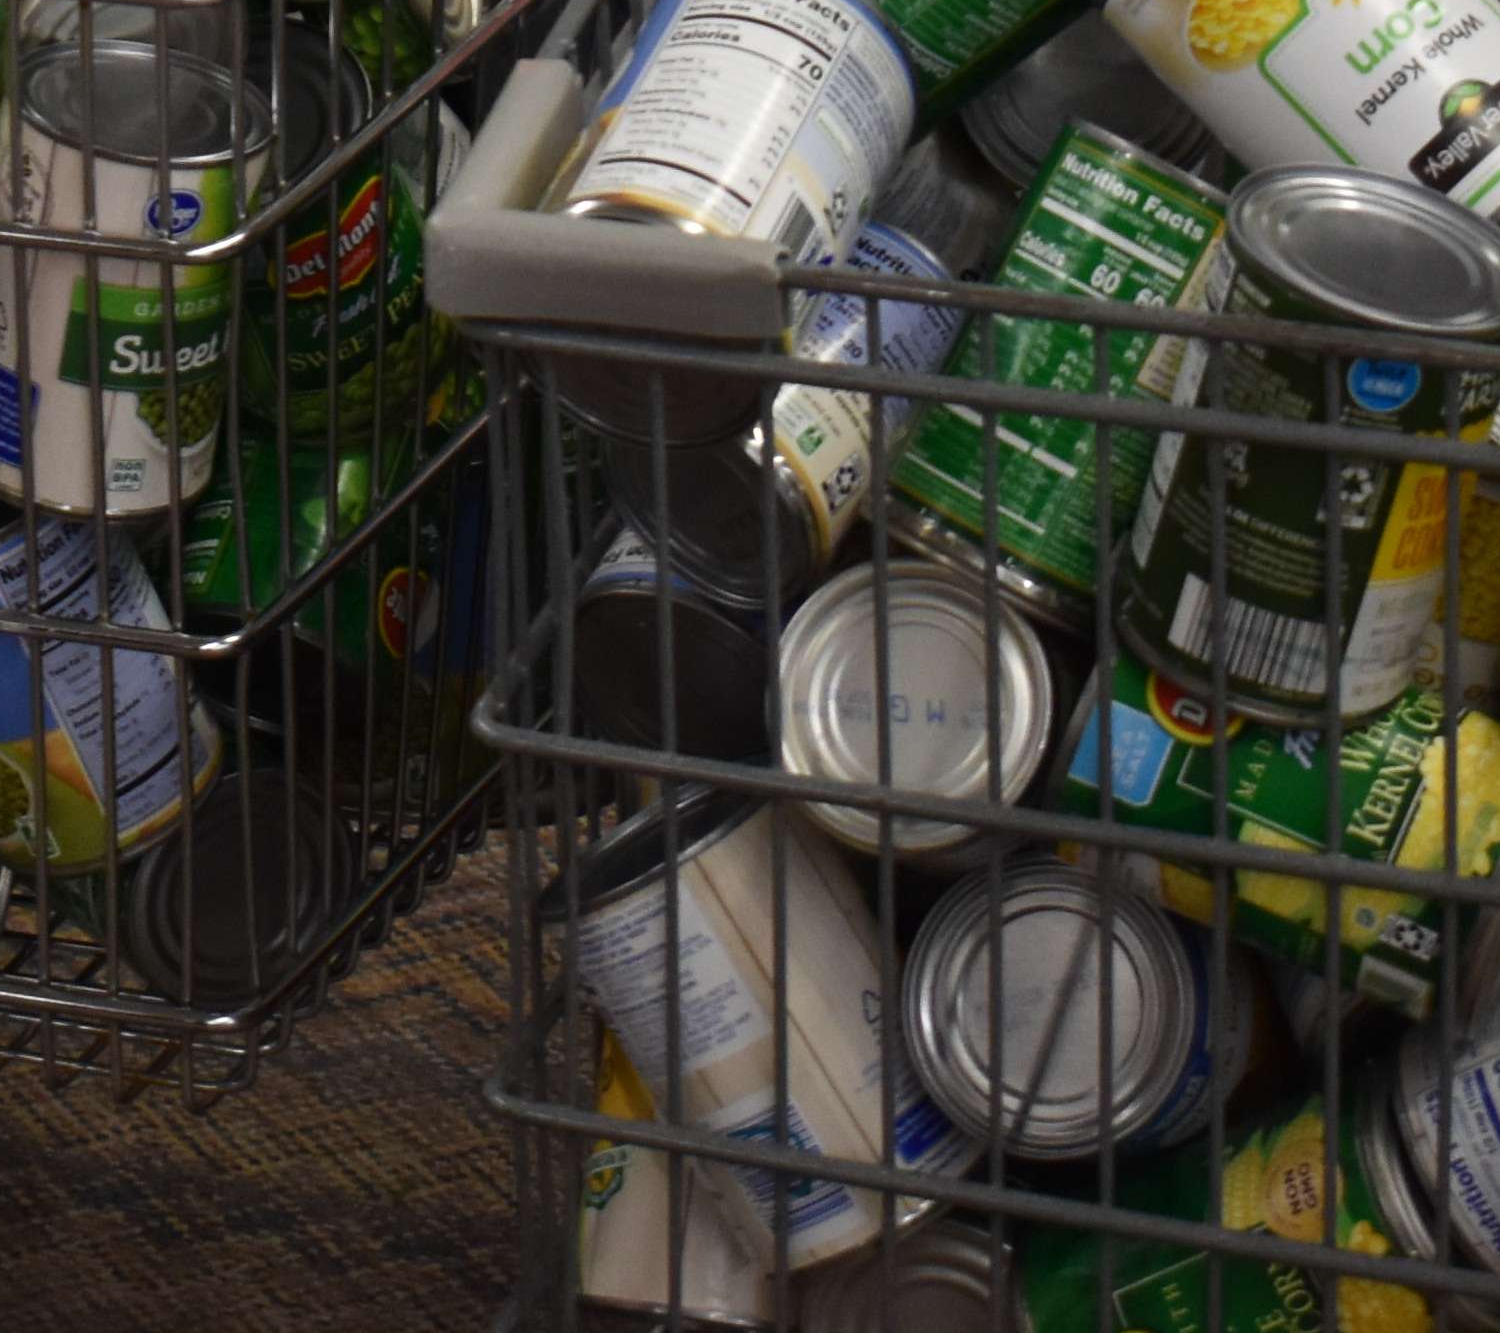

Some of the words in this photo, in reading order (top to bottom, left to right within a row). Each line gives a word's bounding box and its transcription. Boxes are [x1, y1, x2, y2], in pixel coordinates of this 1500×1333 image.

[1420, 11, 1485, 64] Whole
[797, 53, 825, 82] 70
[1353, 55, 1428, 127] Kernel
[1060, 151, 1140, 207] Nutrition
[1141, 193, 1207, 242] Facts
[1089, 263, 1122, 295] 60
[1233, 736, 1274, 802] MAD
